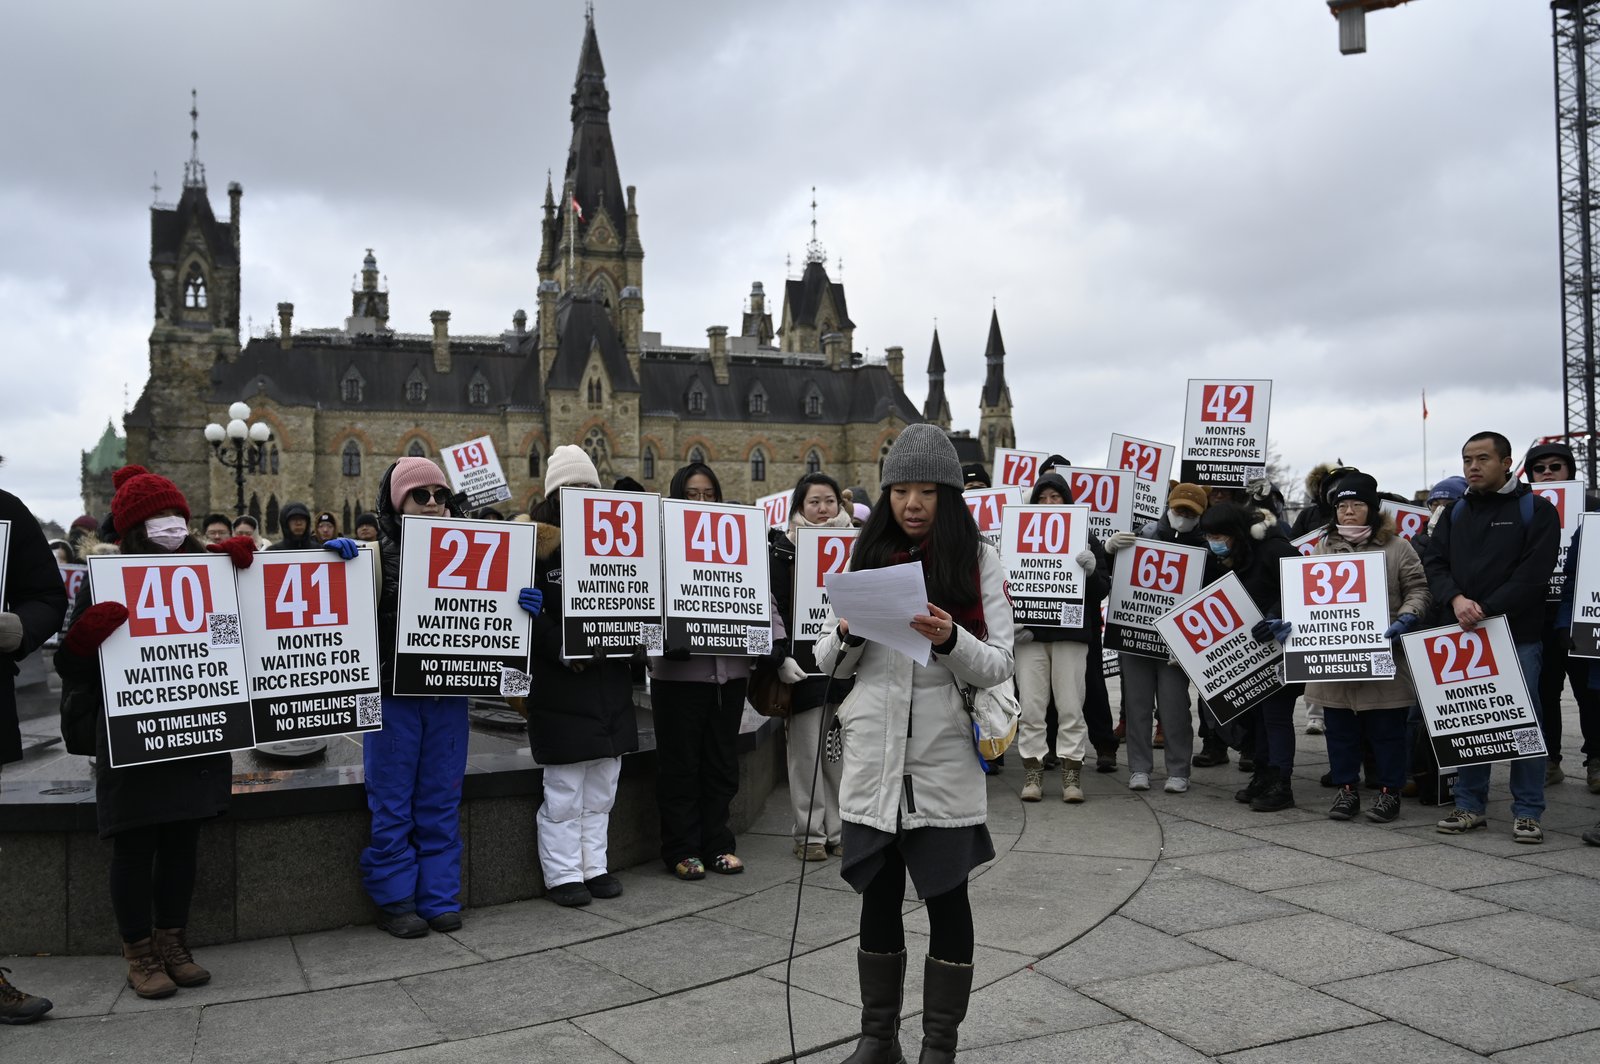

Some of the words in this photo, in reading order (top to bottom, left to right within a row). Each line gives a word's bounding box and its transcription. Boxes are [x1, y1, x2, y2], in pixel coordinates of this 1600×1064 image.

[1207, 386, 1248, 421] 42
[1206, 427, 1245, 435] MONTHS
[1195, 437, 1234, 446] WAITING
[1237, 438, 1255, 447] FOR
[458, 445, 482, 470] 19
[1188, 448, 1208, 456] IRCC
[1210, 449, 1260, 458] RESPONSE
[1123, 444, 1156, 480] 32
[464, 468, 488, 479] MONTHS
[1008, 456, 1032, 486] 72
[460, 477, 484, 487] WAITING
[472, 479, 501, 490] RESPONSE
[1074, 474, 1114, 511] 20
[1142, 494, 1157, 504] FOR
[766, 498, 784, 527] 70
[966, 495, 1001, 529] 71
[1134, 504, 1159, 515] PONSE
[592, 501, 637, 556] 53
[1089, 517, 1110, 526] NTHS
[692, 513, 740, 563] 40
[1023, 513, 1065, 553] 40
[437, 530, 500, 589] 27
[1021, 559, 1062, 568] MONTHS
[590, 564, 636, 576] MONTHS
[693, 569, 742, 583] MONTHS
[1010, 571, 1050, 580] WAITING
[1053, 572, 1072, 581] FOR
[1138, 549, 1180, 591] 65
[578, 580, 624, 593] WAITING
[628, 581, 648, 593] FOR
[1007, 583, 1024, 591] RCC
[1026, 583, 1077, 593] RESPONSE
[1310, 561, 1360, 604] 32
[276, 564, 338, 626] 41
[681, 584, 730, 597] WAITING
[734, 587, 755, 599] FOR
[1133, 591, 1175, 606] MONTHS
[136, 567, 204, 633] 40
[435, 598, 497, 612] MONTHS
[571, 598, 596, 610] IRCC
[600, 598, 655, 610] RESPONSE
[674, 599, 700, 611] IRCC
[702, 601, 763, 614] RESPONSE
[1012, 600, 1023, 608] NO
[1121, 600, 1161, 615] WAITING
[1014, 610, 1026, 618] NO
[1028, 611, 1061, 620] RESULTS
[1113, 611, 1135, 623] IRCC
[1182, 596, 1234, 647] 90
[1310, 609, 1360, 620] MONTHS
[418, 615, 480, 630] WAITING
[484, 618, 512, 631] FOR
[583, 622, 596, 633] NO
[686, 623, 700, 633] NO
[1298, 623, 1347, 633] WAITING
[1352, 621, 1374, 631] FOR
[603, 635, 640, 646] RESULTS
[1120, 629, 1132, 637] NO
[1292, 637, 1317, 647] IRCC
[1320, 633, 1382, 645] RESPONSE
[278, 632, 342, 650] MONTHS
[407, 633, 440, 647] IRCC
[443, 634, 520, 649] RESPONSE
[691, 636, 704, 646] NO
[707, 636, 747, 647] RESULTS
[1123, 639, 1134, 647] NO
[1136, 642, 1170, 653] RESULTS
[1205, 632, 1248, 663] MONTHS
[140, 643, 209, 662] MONTHS
[1304, 655, 1317, 663] NO
[1320, 653, 1371, 663] TIMELINES
[1434, 632, 1491, 682] 22
[261, 652, 326, 671] WAITING
[332, 650, 360, 665] FOR
[421, 660, 438, 671] NO
[441, 660, 503, 672] TIMELINES
[1202, 648, 1244, 679] WAITING
[1204, 678, 1227, 693] IRCC
[1226, 643, 1278, 680] RESPONSE
[124, 665, 193, 685] WAITING
[198, 661, 228, 678] FOR
[1309, 665, 1322, 674] NO
[1325, 664, 1367, 673] RESULTS
[253, 677, 288, 691] IRCC
[290, 667, 369, 688] RESPONSE
[426, 675, 442, 686] NO
[446, 675, 498, 687] RESULTS
[1223, 689, 1236, 702] NO
[1236, 664, 1276, 691] TIMELINES
[117, 688, 153, 707] IRCC
[157, 681, 239, 703] RESPONSE
[1232, 696, 1245, 708] NO
[1246, 677, 1279, 701] RESULTS
[1445, 683, 1496, 700] MONTHS
[270, 702, 288, 716] NO
[290, 696, 356, 713] TIMELINES
[1436, 699, 1487, 716] WAITING
[1490, 695, 1515, 708] FOR
[137, 719, 156, 734] NO
[159, 711, 227, 731] TIMELINES
[276, 718, 294, 731] NO
[298, 712, 351, 728] RESULTS
[1434, 718, 1460, 730] IRCC
[1462, 707, 1526, 726] RESPONSE
[145, 736, 164, 751] NO
[167, 728, 223, 747] RESULTS
[1451, 737, 1465, 747] NO
[1466, 730, 1513, 745] TIMELINE
[1459, 748, 1473, 758] NO
[1475, 743, 1517, 756] RESULTS
